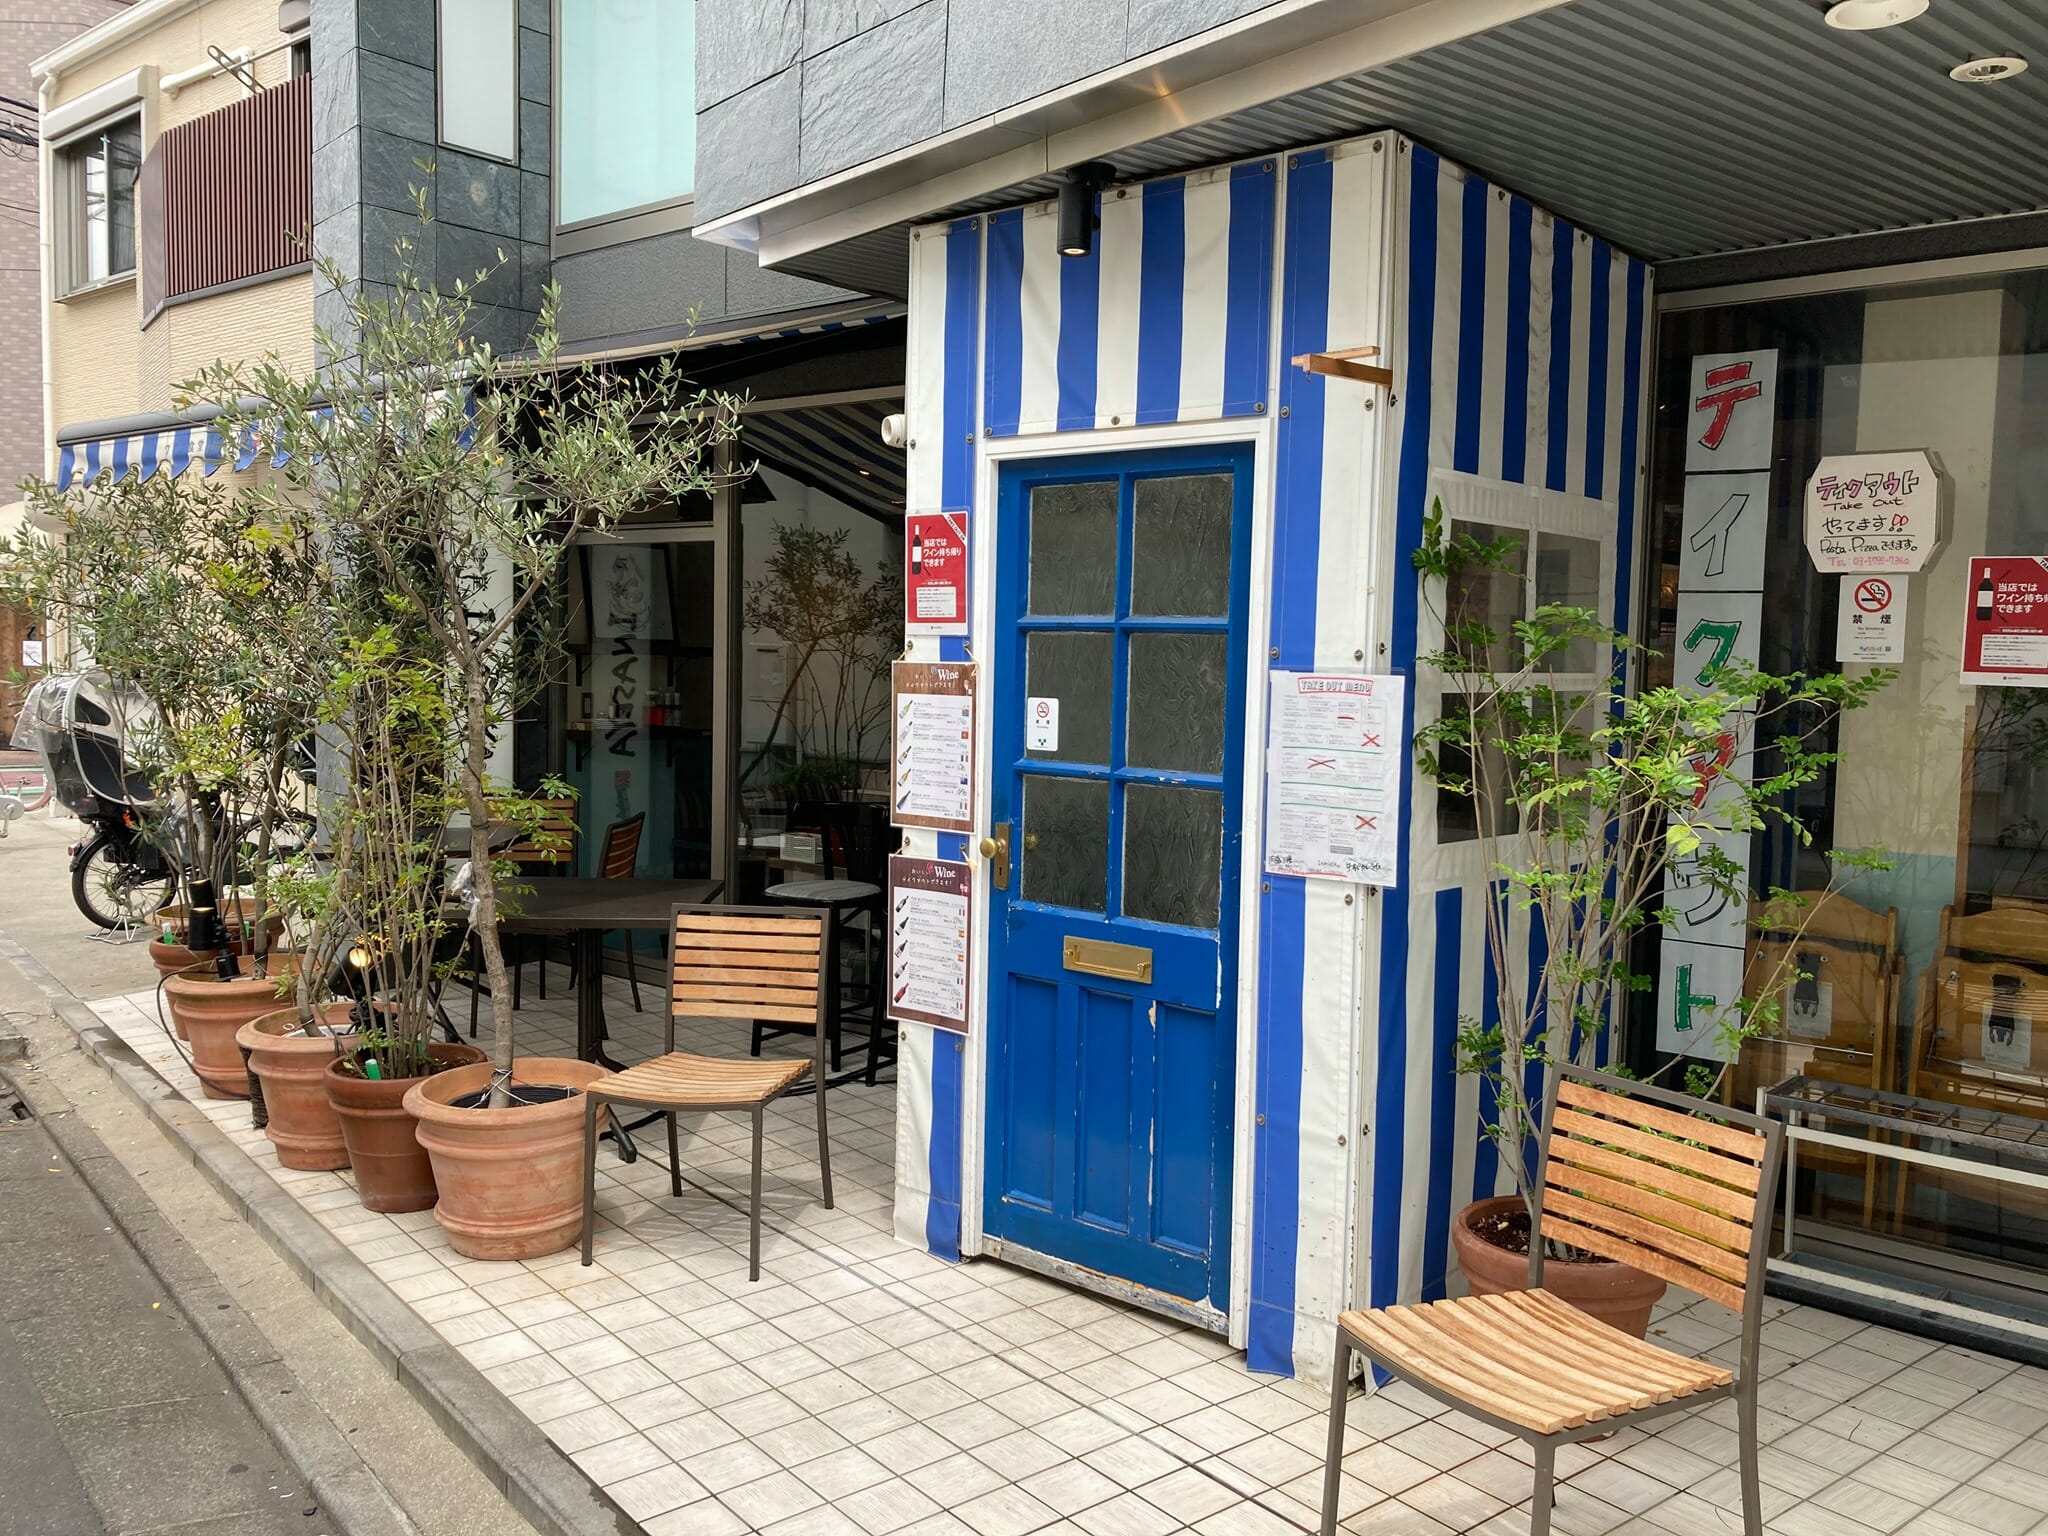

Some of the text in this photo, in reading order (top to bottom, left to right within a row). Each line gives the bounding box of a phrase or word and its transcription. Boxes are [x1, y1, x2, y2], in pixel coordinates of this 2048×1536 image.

[1823, 501, 1864, 511] Take
[924, 539, 947, 547] 当店では
[923, 546, 962, 557] ワイン持ち帰り
[923, 559, 945, 567] できます
[1998, 583, 2038, 592] 当店では
[1996, 604, 2034, 614] できます
[938, 669, 959, 680] Wine
[1301, 680, 1371, 693] TAKE OUT MENU
[935, 866, 956, 877] Wine
